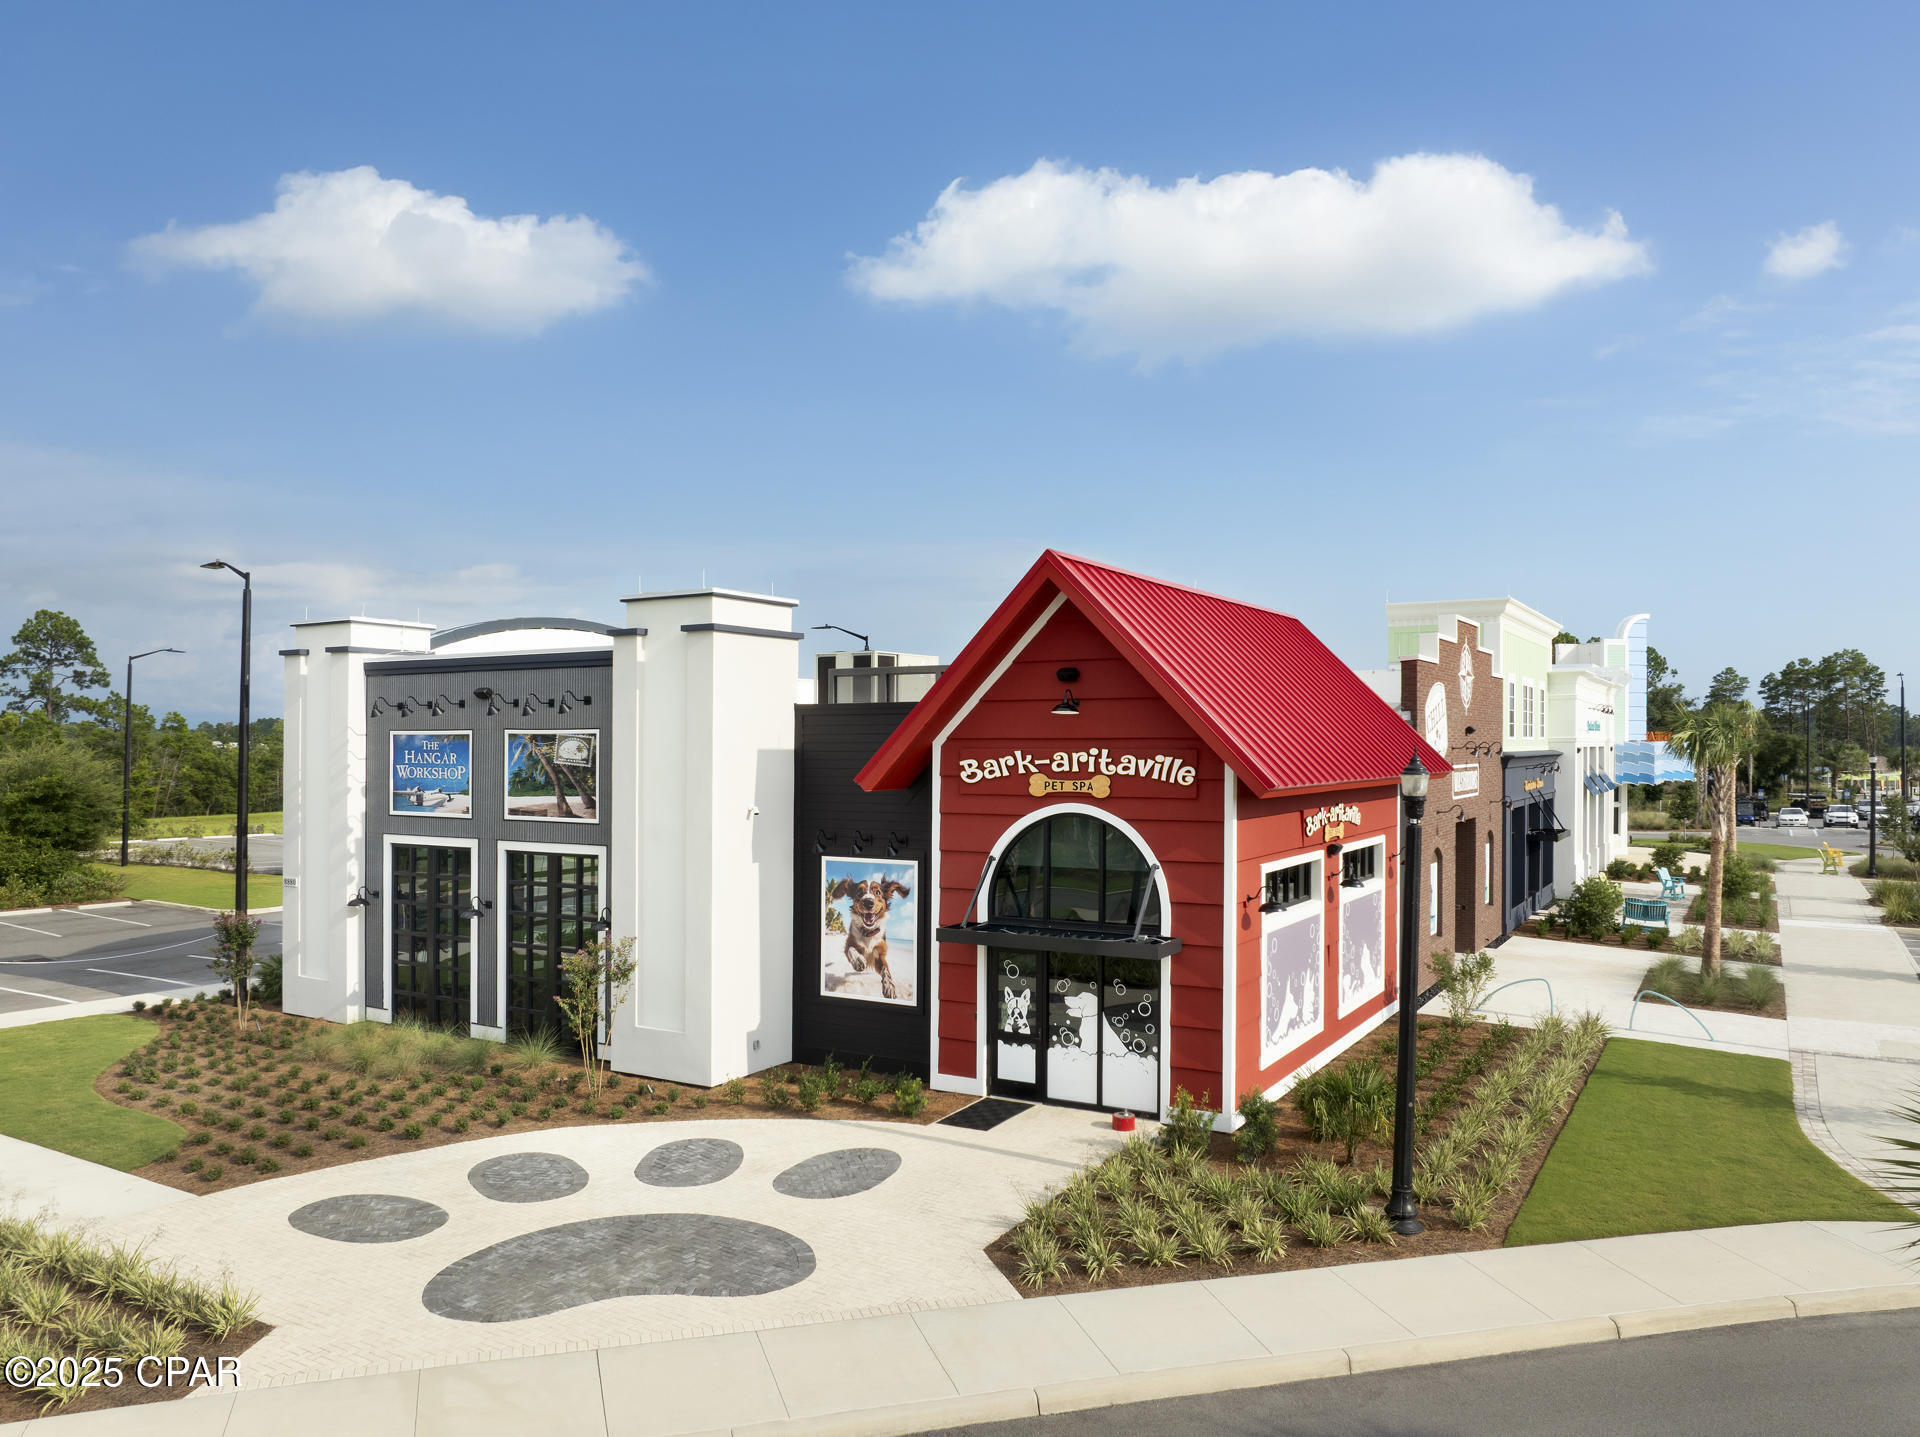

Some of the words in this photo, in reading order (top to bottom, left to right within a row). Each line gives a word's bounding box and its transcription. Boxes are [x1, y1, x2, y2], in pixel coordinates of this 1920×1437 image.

[422, 740, 440, 750] THE
[404, 750, 457, 765] HANGAR
[396, 765, 466, 780] WORKSHOP
[959, 747, 1196, 786] Bark-aritaville
[1044, 781, 1066, 791] PET
[1072, 781, 1094, 791] SPA
